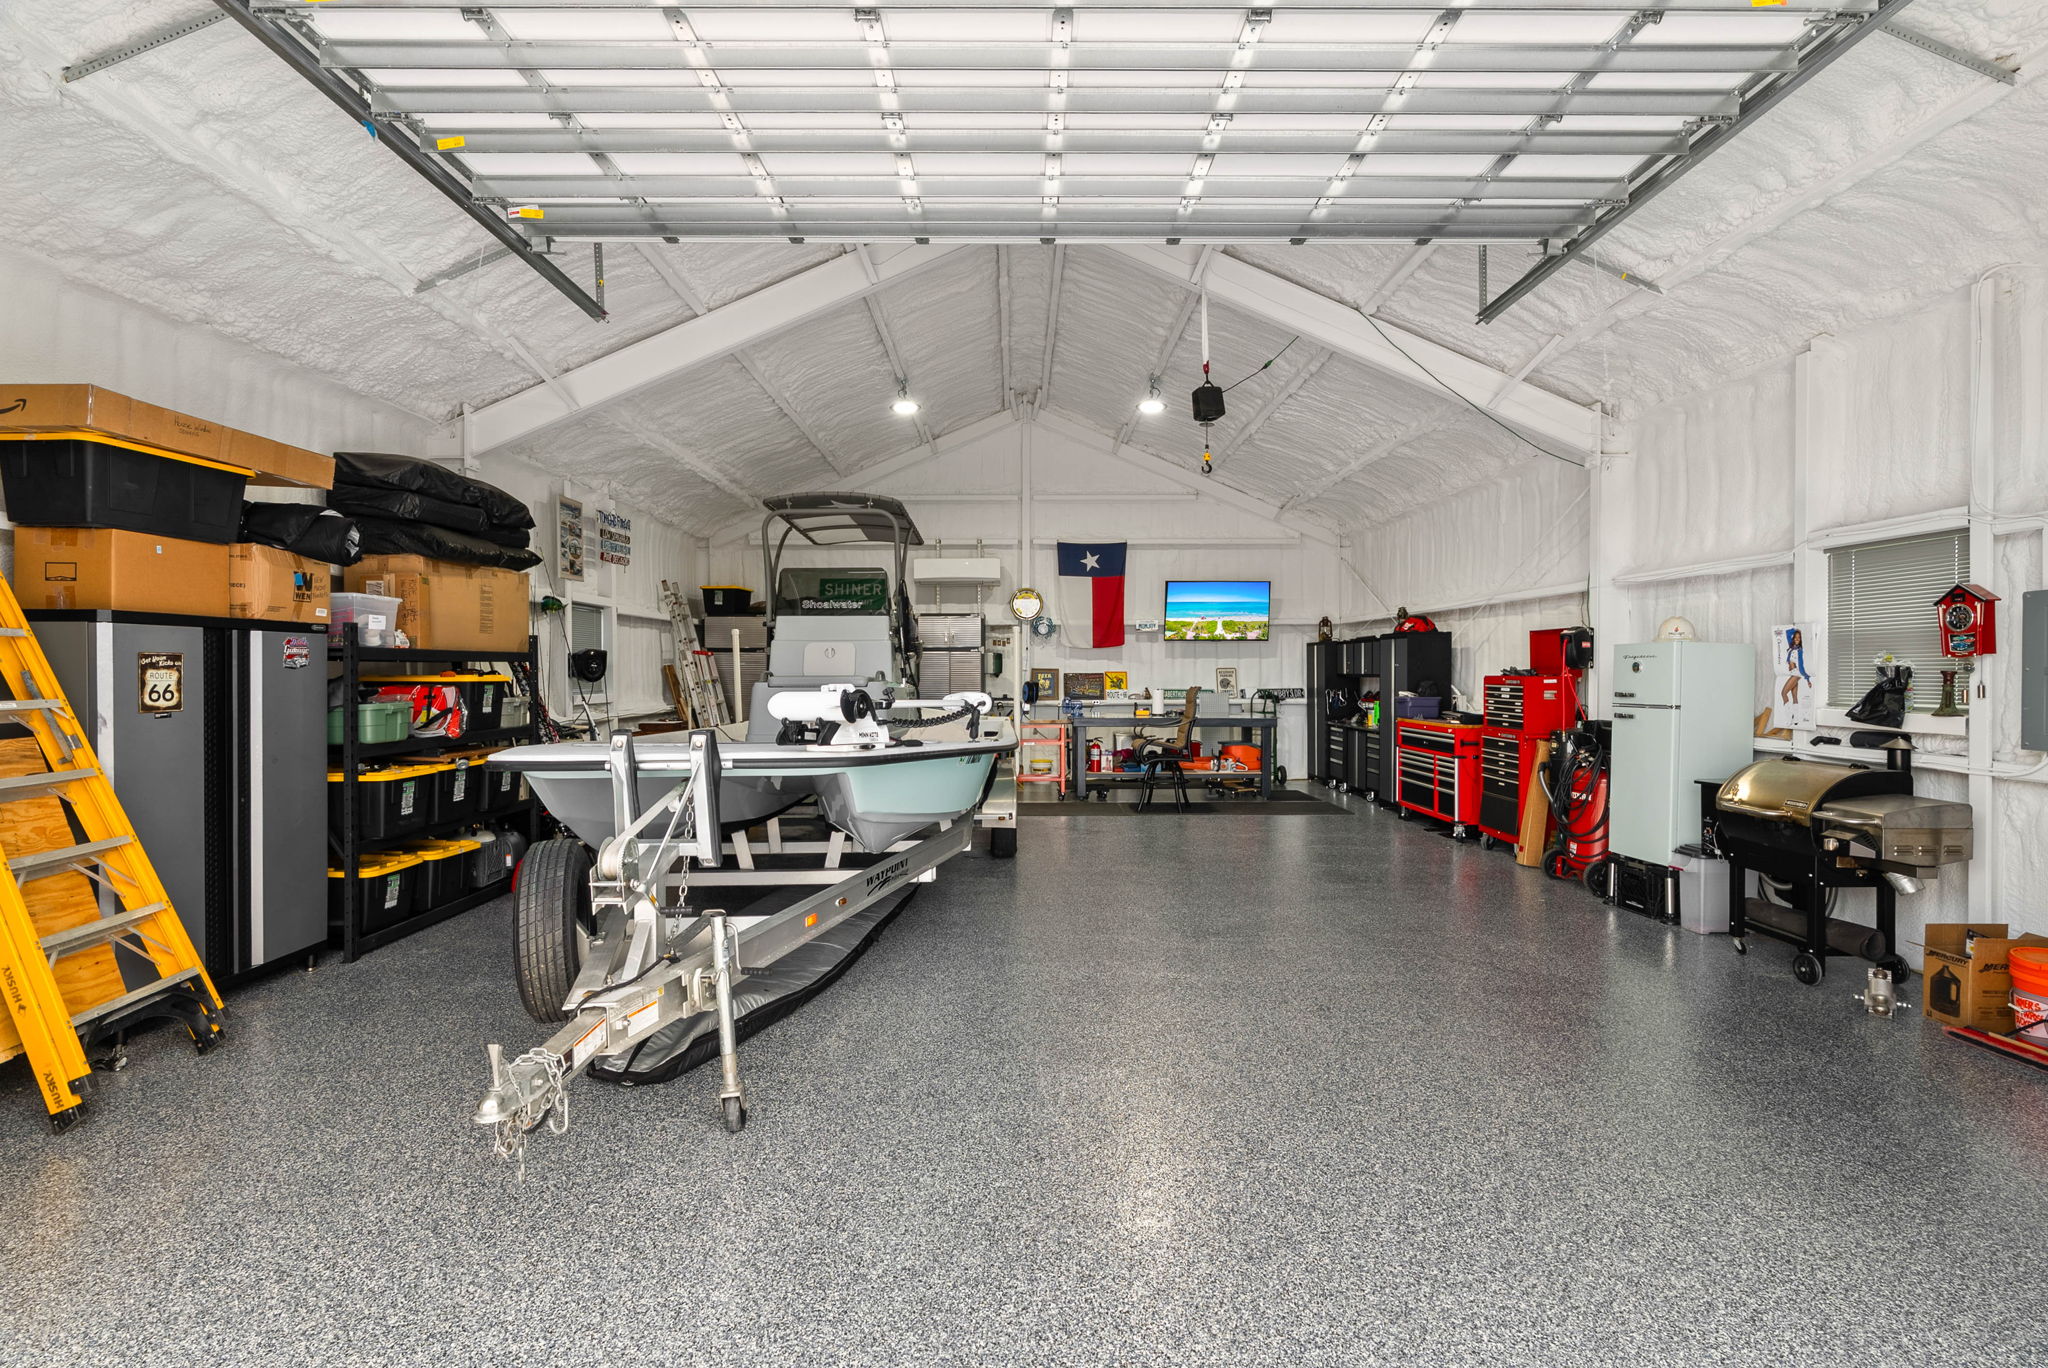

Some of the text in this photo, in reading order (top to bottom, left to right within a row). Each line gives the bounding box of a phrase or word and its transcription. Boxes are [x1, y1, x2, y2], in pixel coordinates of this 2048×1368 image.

[295, 591, 312, 601] WEN
[824, 583, 882, 596] SHINER
[801, 600, 864, 609] Shoalwater
[149, 672, 173, 680] ROUTE
[148, 683, 175, 703] 66
[866, 858, 909, 887] WAYPOINT
[1926, 950, 1968, 965] MERCURY
[2, 966, 22, 1003] HUSKY
[43, 1072, 65, 1109] HUSKY
